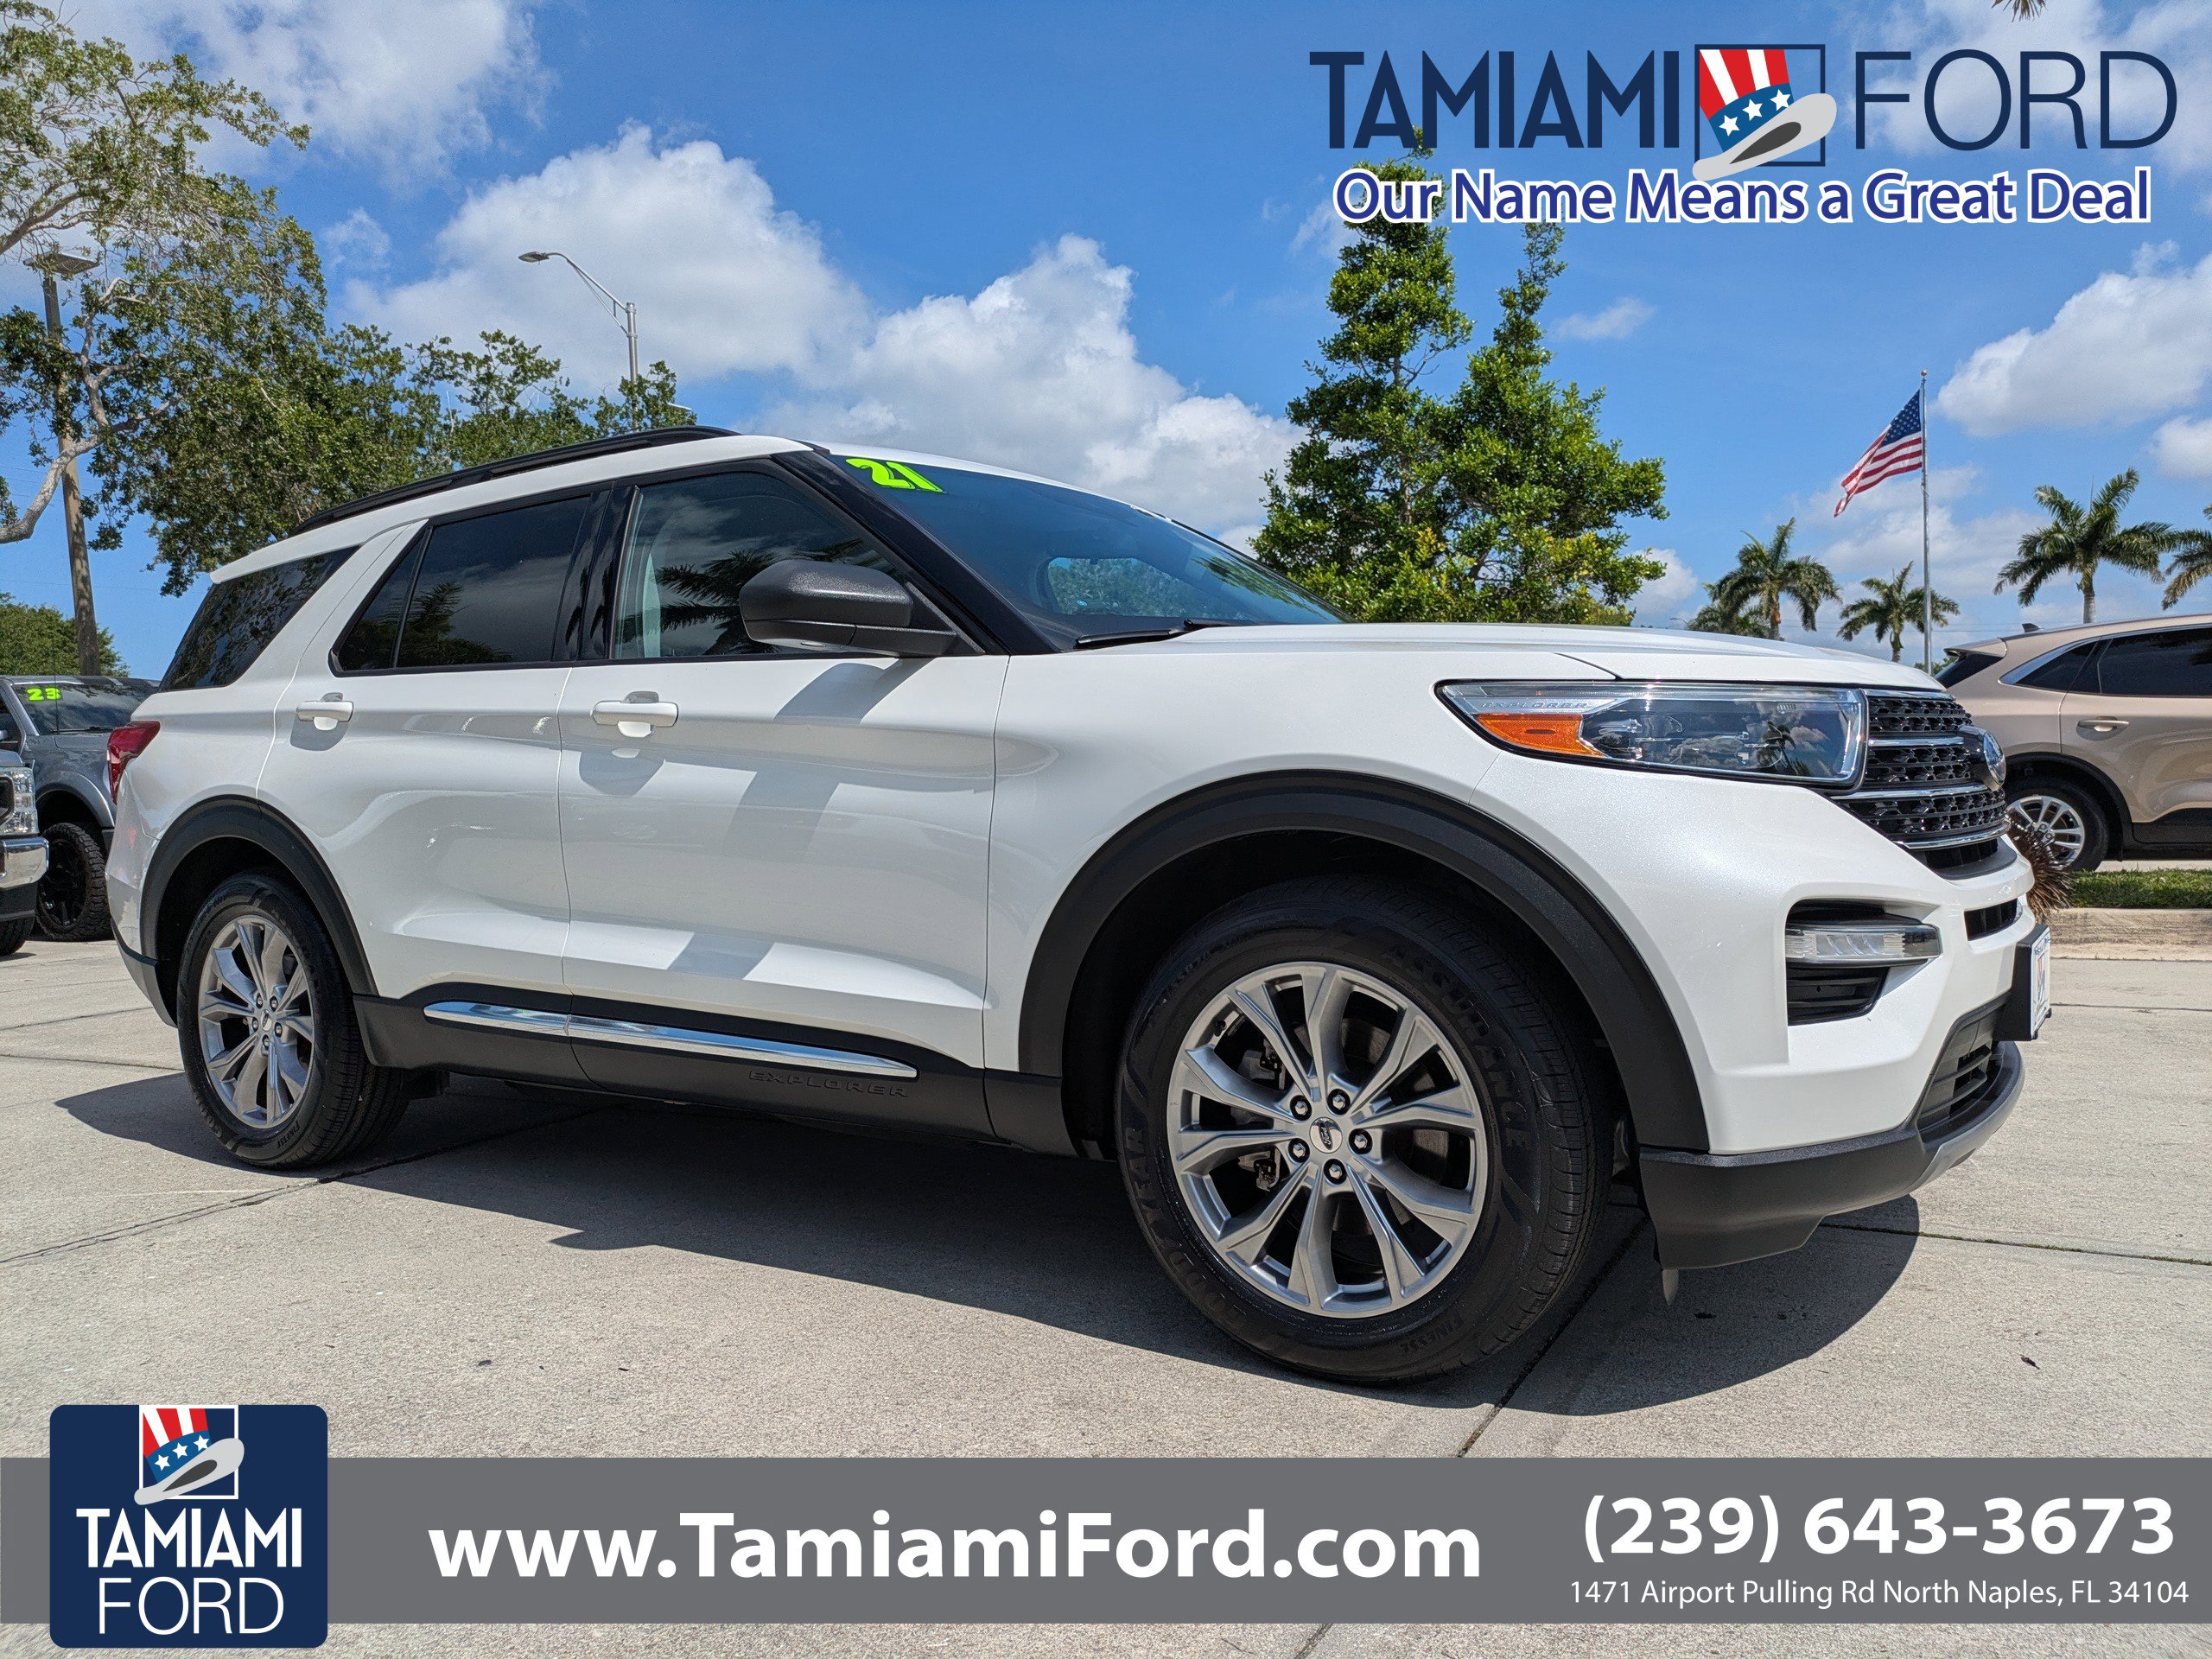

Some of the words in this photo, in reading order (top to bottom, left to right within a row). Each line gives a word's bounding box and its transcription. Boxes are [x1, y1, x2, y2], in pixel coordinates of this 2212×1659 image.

[846, 457, 943, 493] 21
[27, 687, 60, 701] 23
[749, 1070, 908, 1097] EXPLORER
